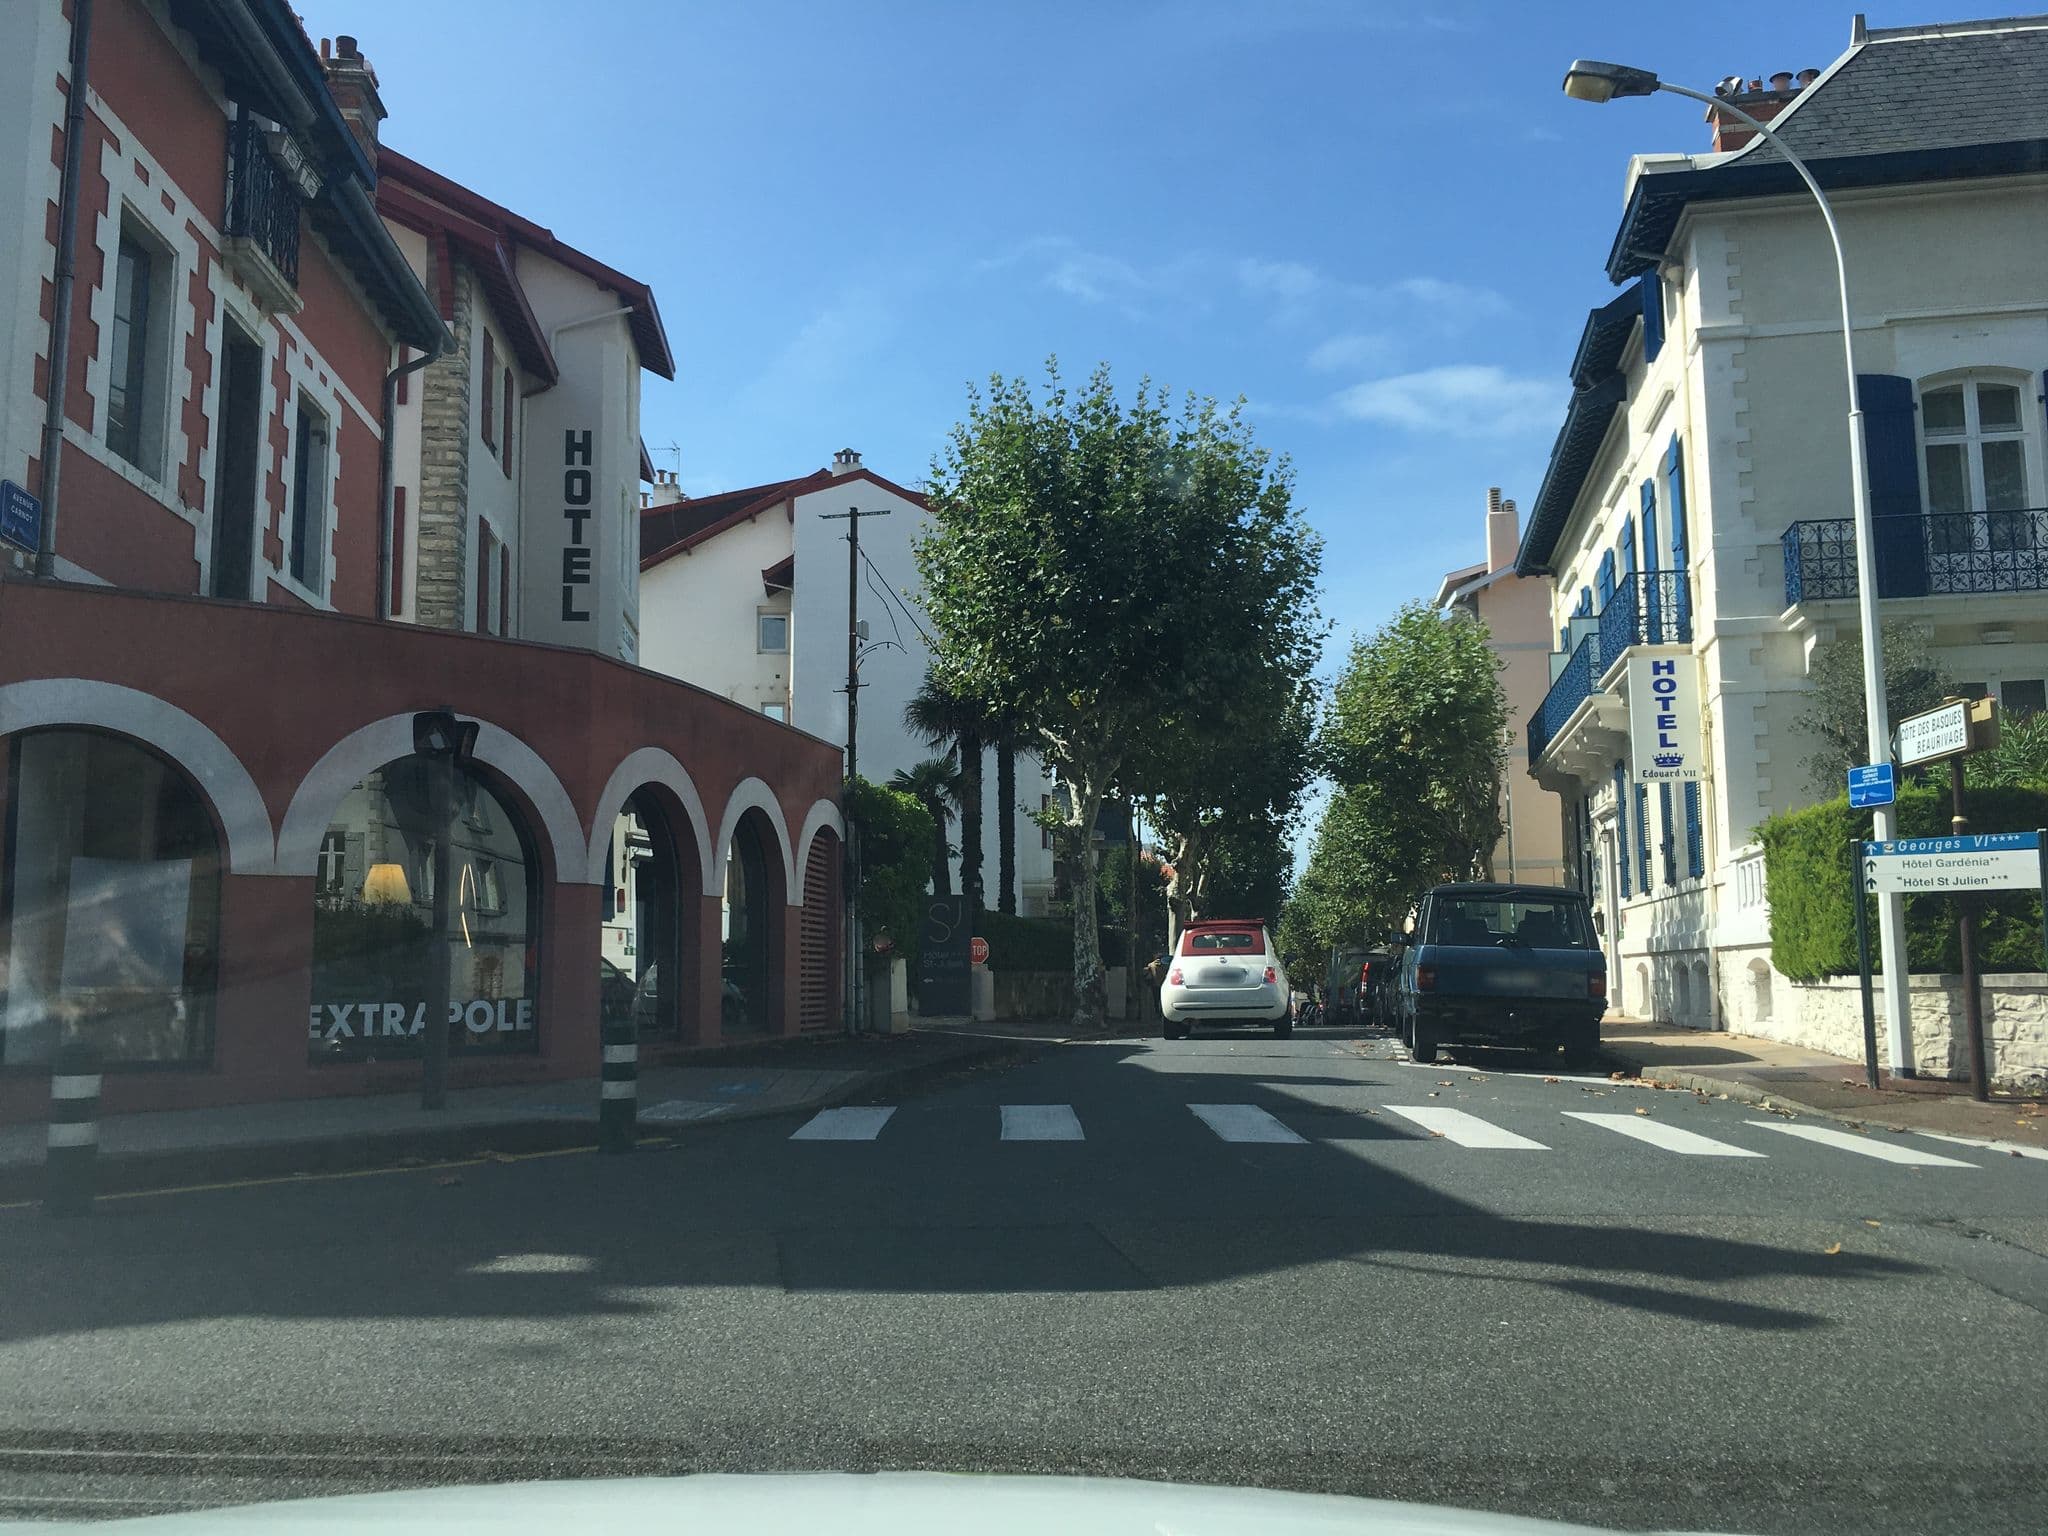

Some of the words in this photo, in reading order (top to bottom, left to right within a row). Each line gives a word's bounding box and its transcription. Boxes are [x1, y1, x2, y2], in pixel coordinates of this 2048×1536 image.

[562, 430, 592, 621] HOTEL
[1652, 660, 1678, 748] HOTEL
[1918, 720, 1930, 736] DES
[1931, 710, 1961, 731] BASQUES
[1917, 727, 1963, 753] BEAURIVAGE
[1642, 769, 1680, 778] Edouard
[1898, 839, 1961, 852] Georges
[1902, 857, 1932, 868] Hôtel
[1903, 874, 1934, 887] Hôtel
[1937, 875, 1949, 886] St
[1952, 874, 1988, 886] Julien
[972, 945, 987, 956] TOP
